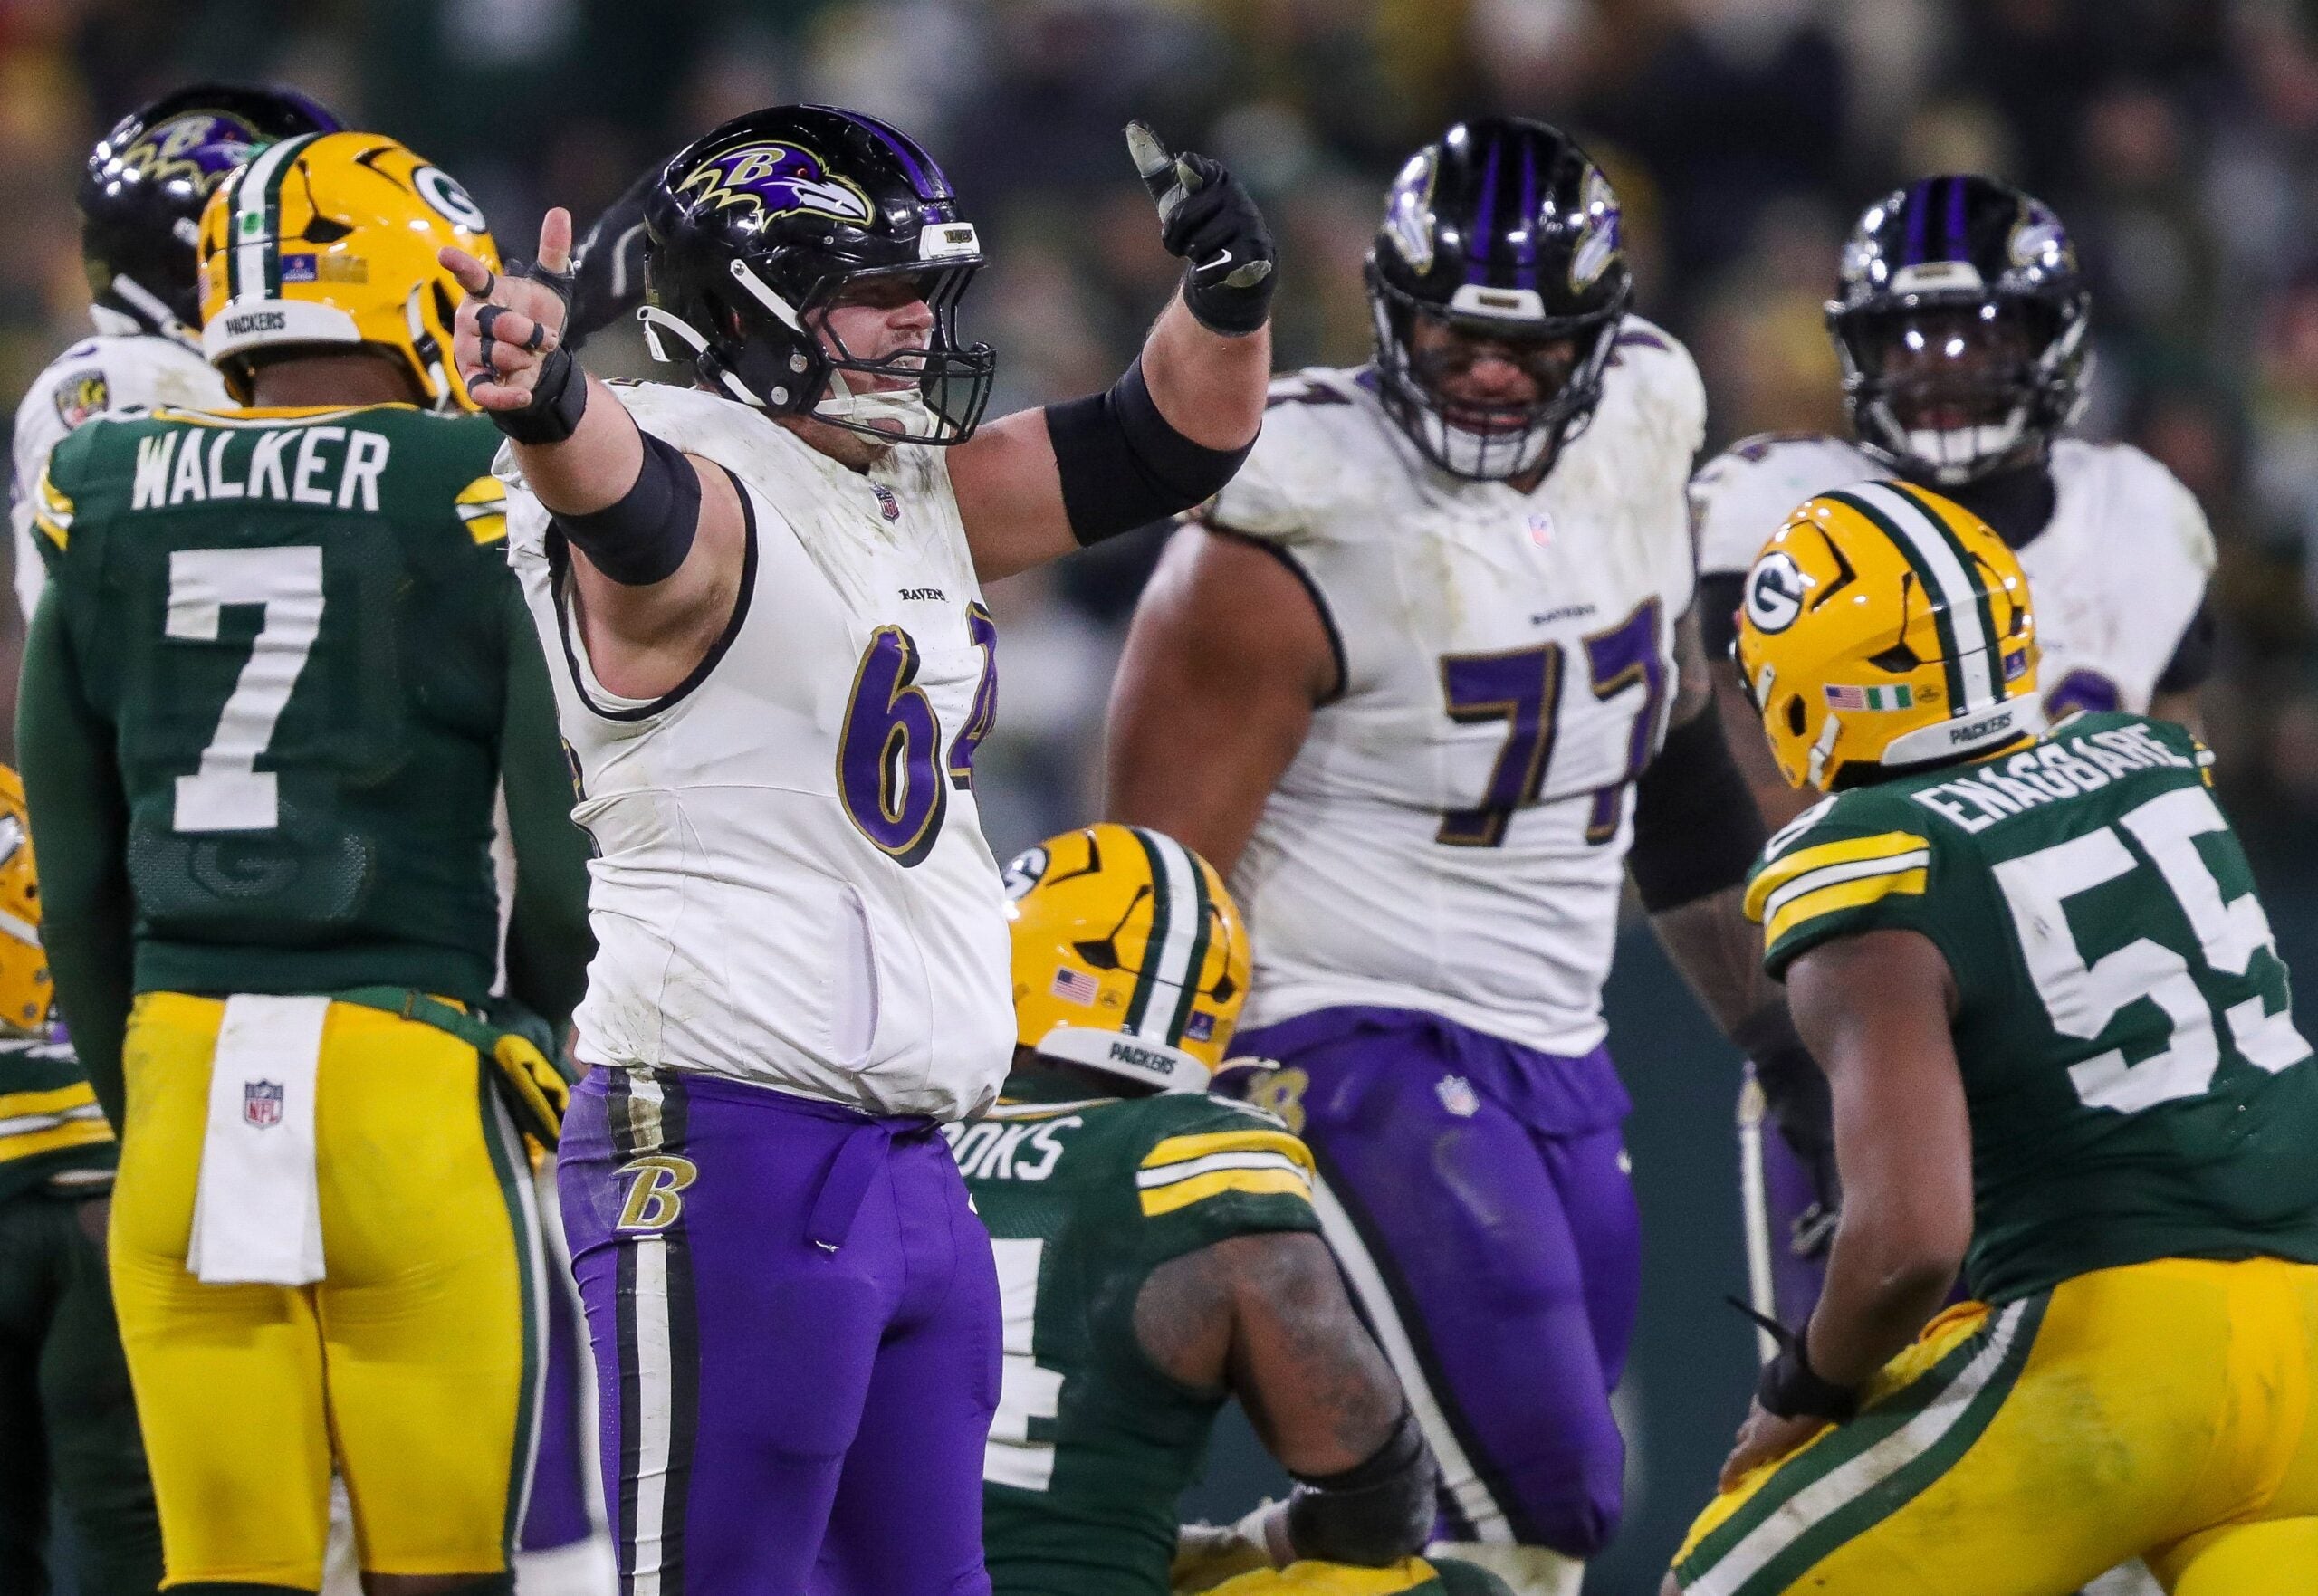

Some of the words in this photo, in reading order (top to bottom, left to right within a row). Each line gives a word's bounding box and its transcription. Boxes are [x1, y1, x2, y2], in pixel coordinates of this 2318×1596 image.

[719, 147, 786, 186] B
[131, 426, 390, 512] WALKER
[165, 545, 326, 833] 7
[835, 596, 998, 868] 64
[1435, 591, 1671, 848] 77
[1949, 711, 2013, 745] PACKERS
[1911, 722, 2194, 834] ENAGBARE
[1990, 785, 2314, 1115] 55
[1110, 1041, 1176, 1075] PACKERS
[610, 1154, 698, 1231] B
